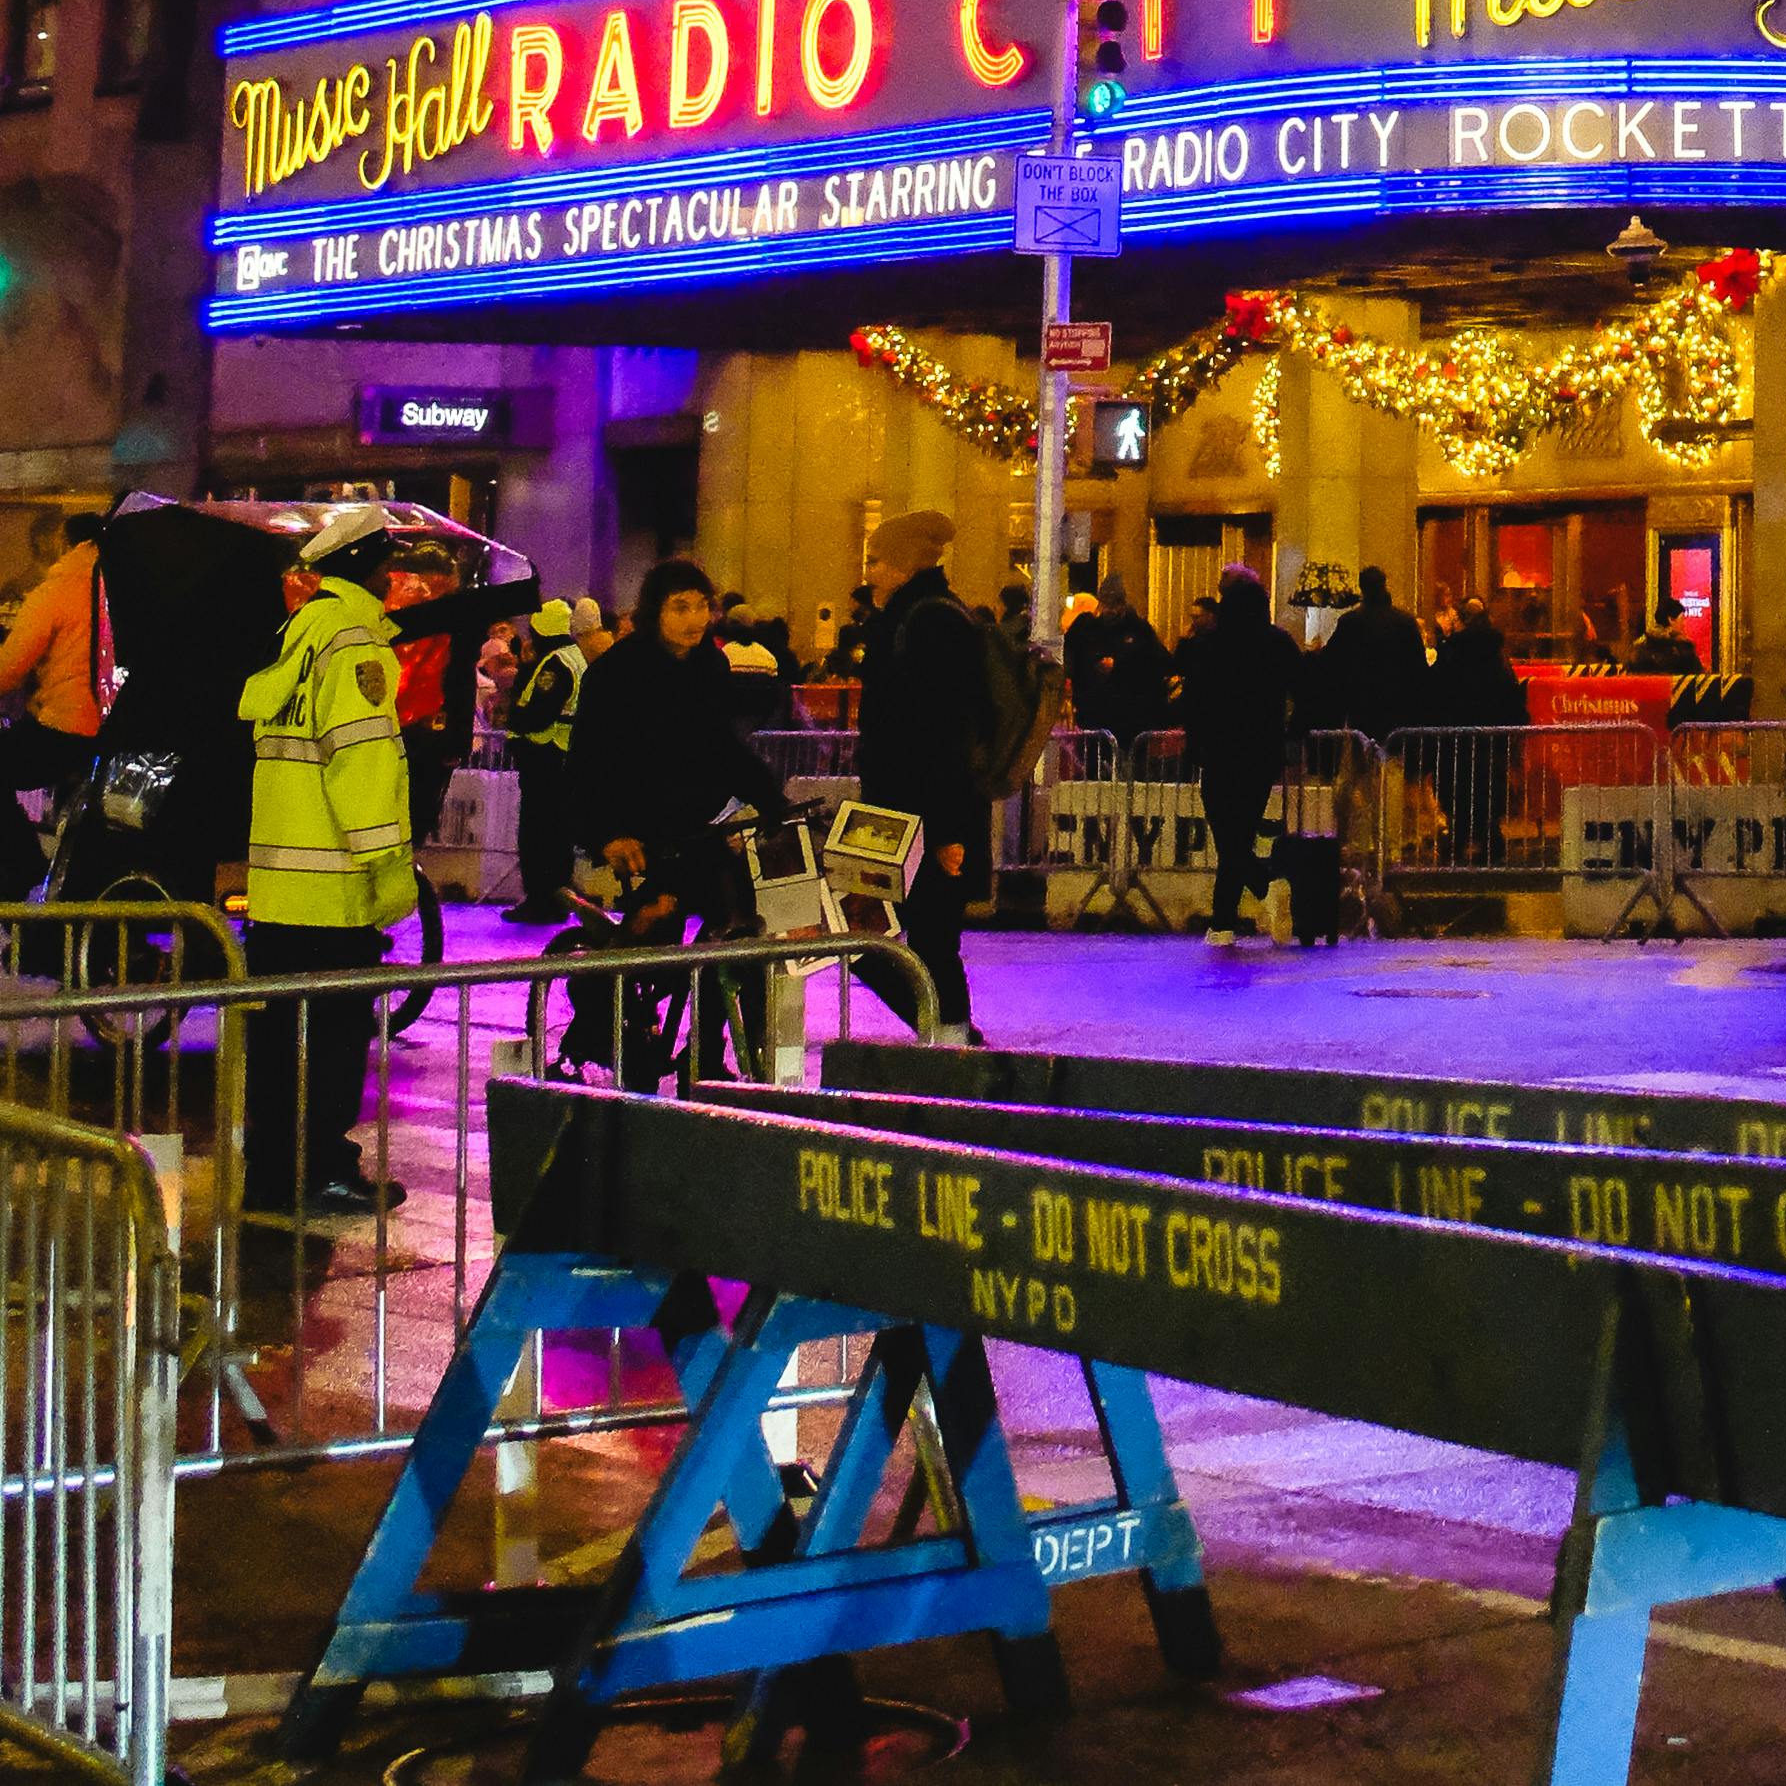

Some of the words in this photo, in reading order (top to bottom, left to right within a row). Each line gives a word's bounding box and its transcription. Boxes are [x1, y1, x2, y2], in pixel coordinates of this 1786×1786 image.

[231, 63, 371, 200] Music
[358, 10, 494, 191] Hall
[1023, 163, 1064, 179] DON'T
[1069, 165, 1114, 182] BLOCK
[1122, 123, 1249, 196] RADIO
[1278, 110, 1400, 174] CITY
[312, 233, 360, 283] THE
[378, 211, 542, 276] CHRISTMAS
[562, 180, 798, 257] SPECTACULAR
[821, 155, 997, 227] STARRING
[1039, 184, 1065, 201] THE
[1071, 187, 1098, 202] BOX
[401, 401, 488, 432] Subway
[1550, 693, 1640, 715] Christmas
[799, 1148, 895, 1230] POLICE
[918, 1170, 984, 1252] LINE
[1029, 1186, 1074, 1264] DO
[1085, 1196, 1152, 1278] NOT
[1164, 1210, 1282, 1306] CROSS
[1568, 1176, 1630, 1245] DO
[1653, 1182, 1751, 1257] NOT
[970, 1266, 1078, 1334] NYPD
[1034, 1511, 1143, 1578] DEPT
